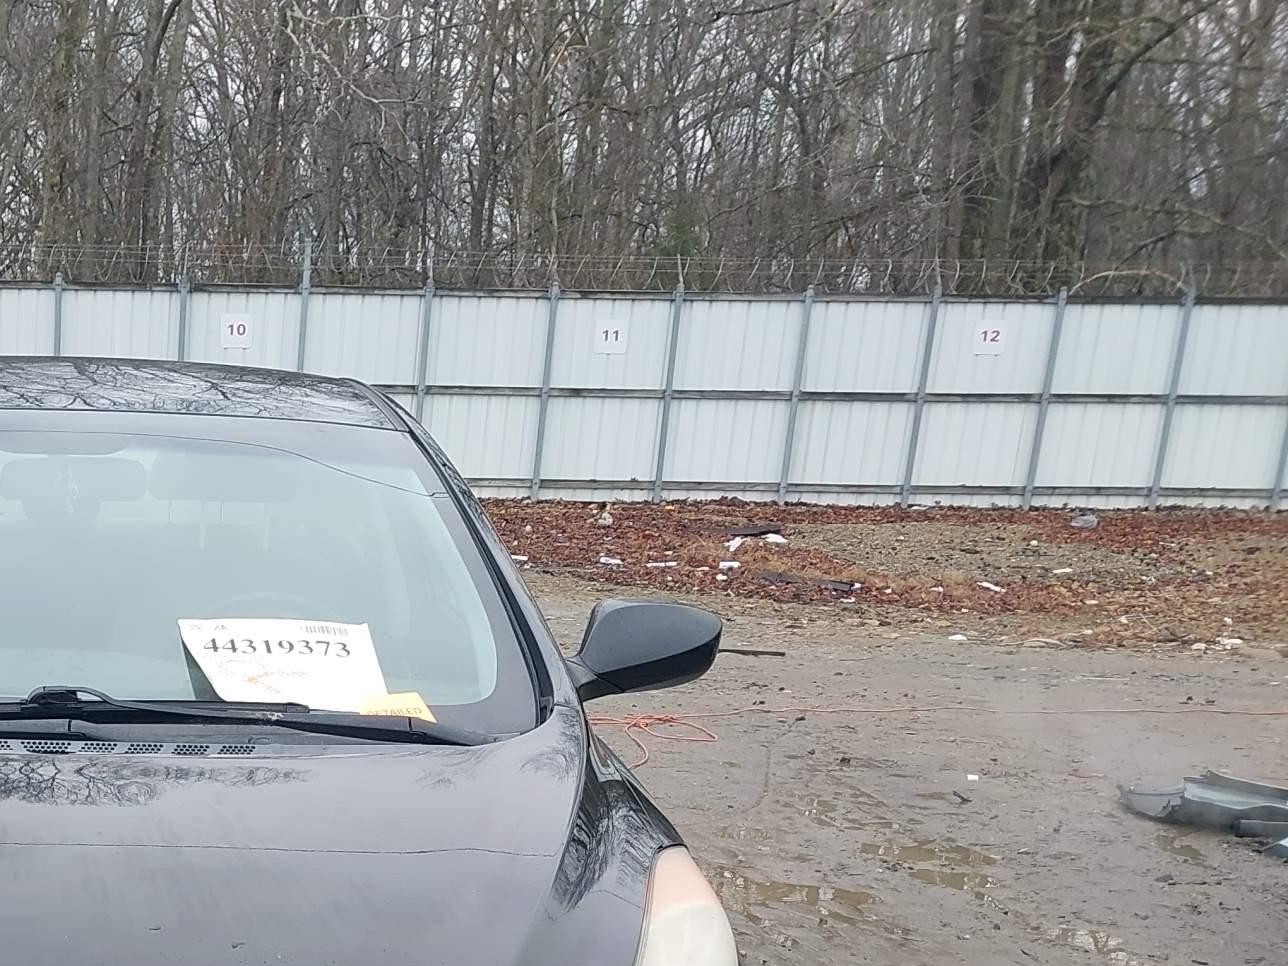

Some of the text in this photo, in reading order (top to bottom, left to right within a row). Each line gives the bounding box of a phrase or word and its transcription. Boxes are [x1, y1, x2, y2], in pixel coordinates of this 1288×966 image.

[227, 324, 247, 336] 10
[602, 329, 620, 342] 11
[981, 330, 1001, 342] 12
[203, 637, 351, 658] 44319373
